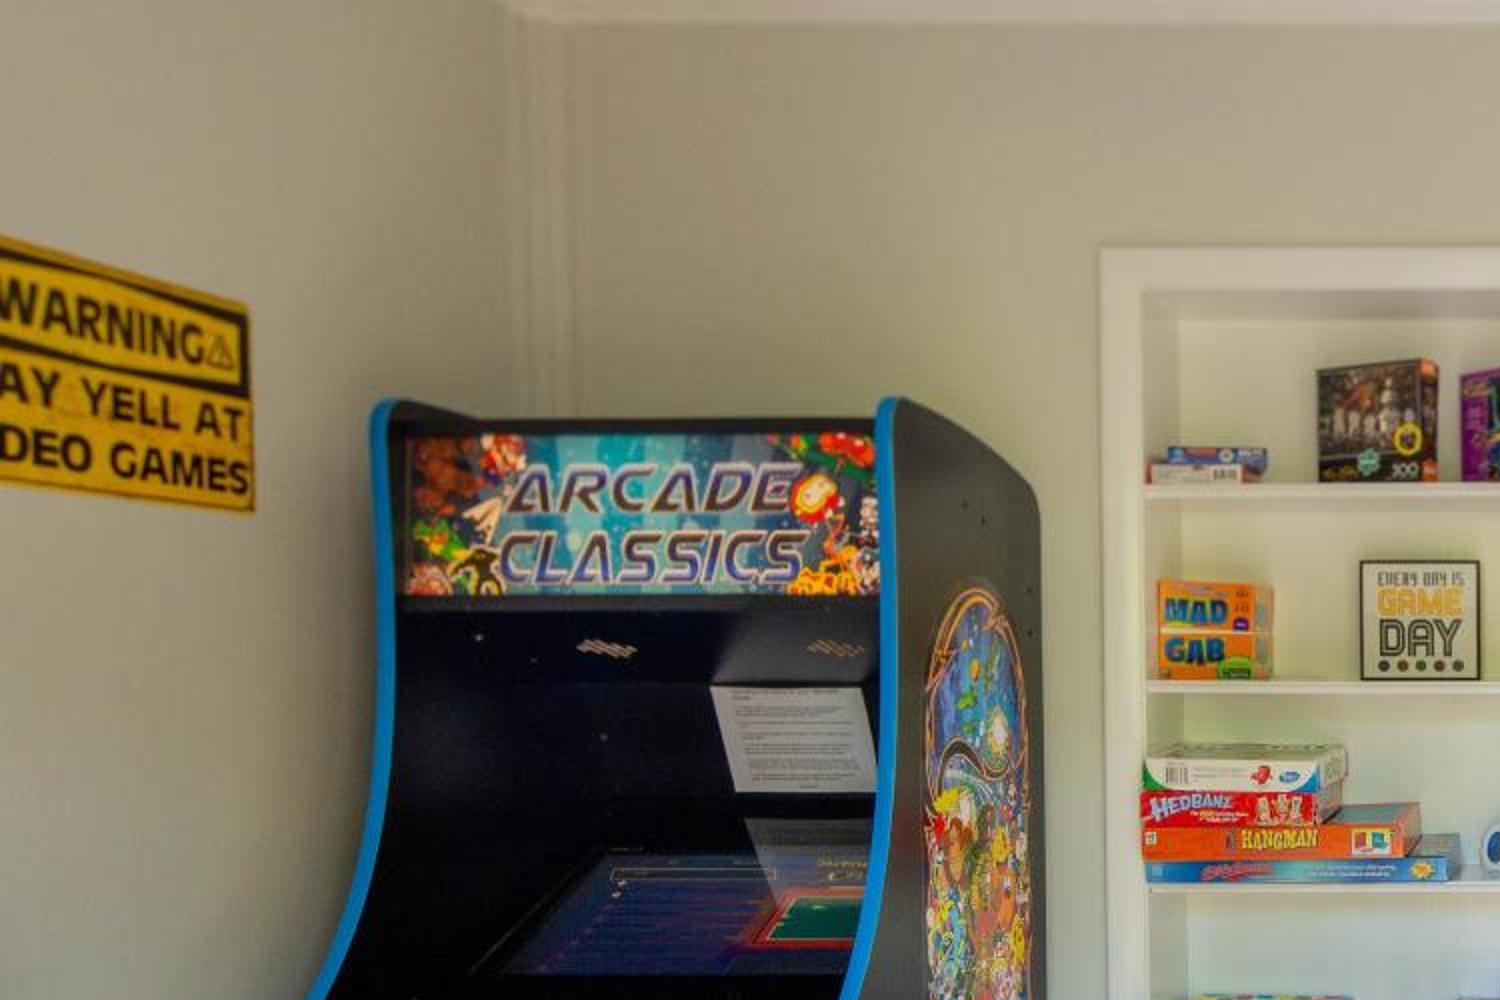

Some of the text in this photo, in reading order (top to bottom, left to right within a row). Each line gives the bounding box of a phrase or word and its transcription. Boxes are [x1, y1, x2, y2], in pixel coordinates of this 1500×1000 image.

[0, 276, 205, 365] WARNING
[80, 376, 181, 432] YELL
[195, 401, 244, 442] AT
[110, 441, 249, 496] GAMES
[504, 462, 803, 514] ARCADE
[499, 530, 811, 586] CLASSICS
[1377, 571, 1418, 587] EVERY
[1451, 571, 1465, 586] IS
[1164, 597, 1229, 625] MAD
[1376, 586, 1465, 617] GAME
[1164, 636, 1226, 666] GAB
[1379, 618, 1462, 657] DAY
[1241, 829, 1319, 850] HANGMAN
